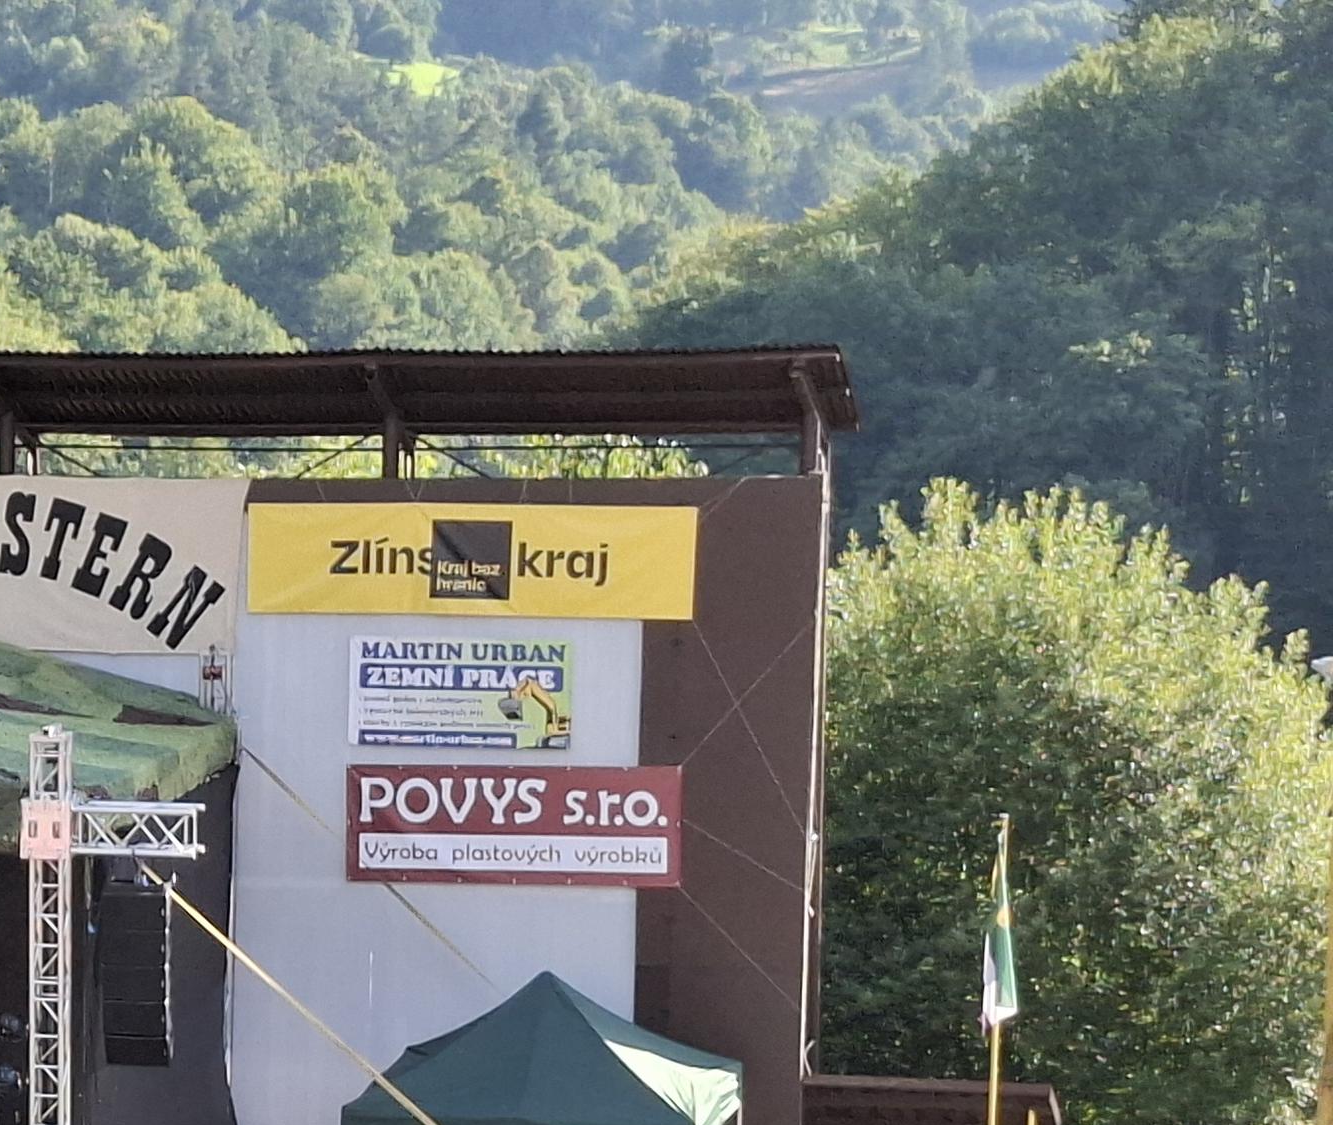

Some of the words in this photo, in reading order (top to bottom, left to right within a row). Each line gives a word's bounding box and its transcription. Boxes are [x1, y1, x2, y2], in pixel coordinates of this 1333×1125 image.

[330, 537, 432, 575] Zlíns
[517, 542, 609, 587] kraj
[361, 641, 463, 660] MARTIN
[471, 643, 566, 662] URBAN
[366, 665, 455, 687] ZEMNÍ
[359, 777, 547, 824] POVYS
[563, 789, 668, 827] s.r.o.
[364, 840, 438, 863] Výroba
[452, 844, 561, 865] plastových
[575, 846, 663, 865] výrobků
